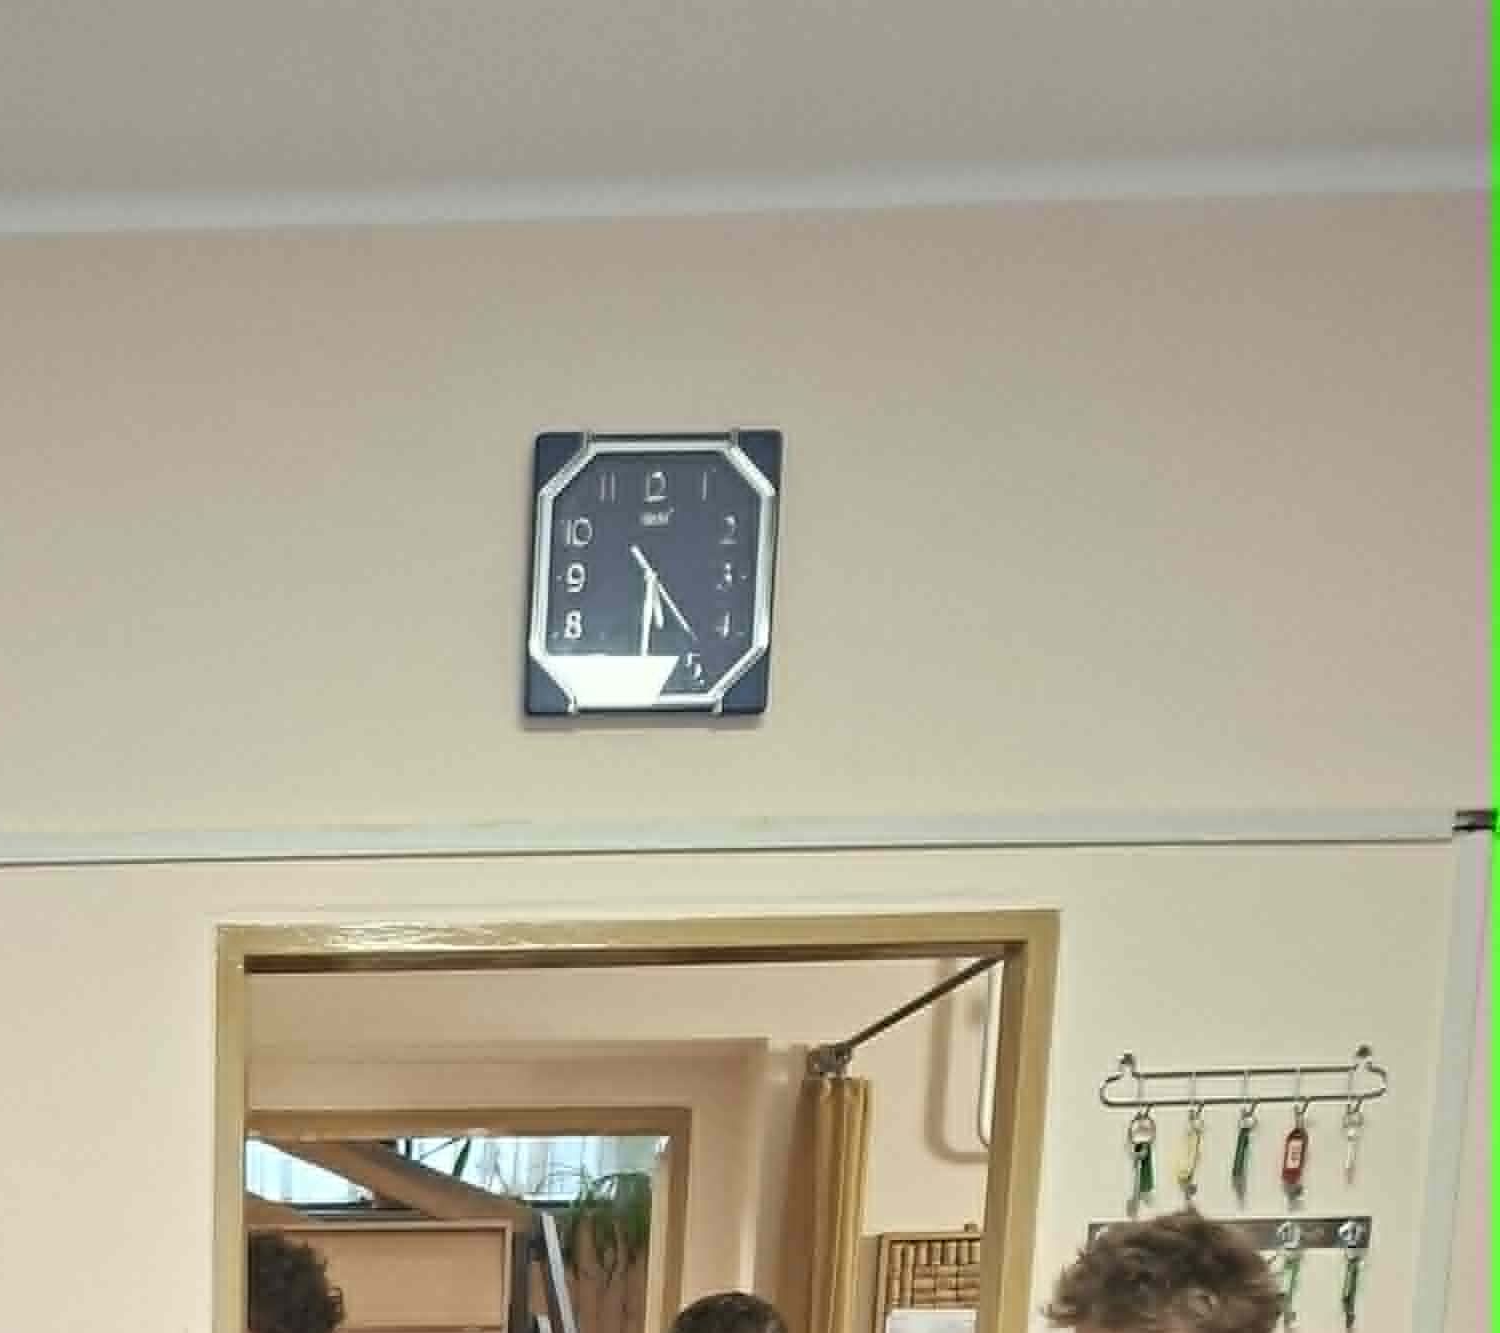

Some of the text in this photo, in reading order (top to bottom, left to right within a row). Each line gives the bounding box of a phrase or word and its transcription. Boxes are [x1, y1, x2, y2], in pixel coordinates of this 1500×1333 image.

[600, 471, 616, 502] 11
[643, 471, 668, 503] 12
[564, 516, 593, 546] 10
[718, 515, 738, 545] 2
[566, 562, 586, 592] 9
[564, 609, 583, 639] 8
